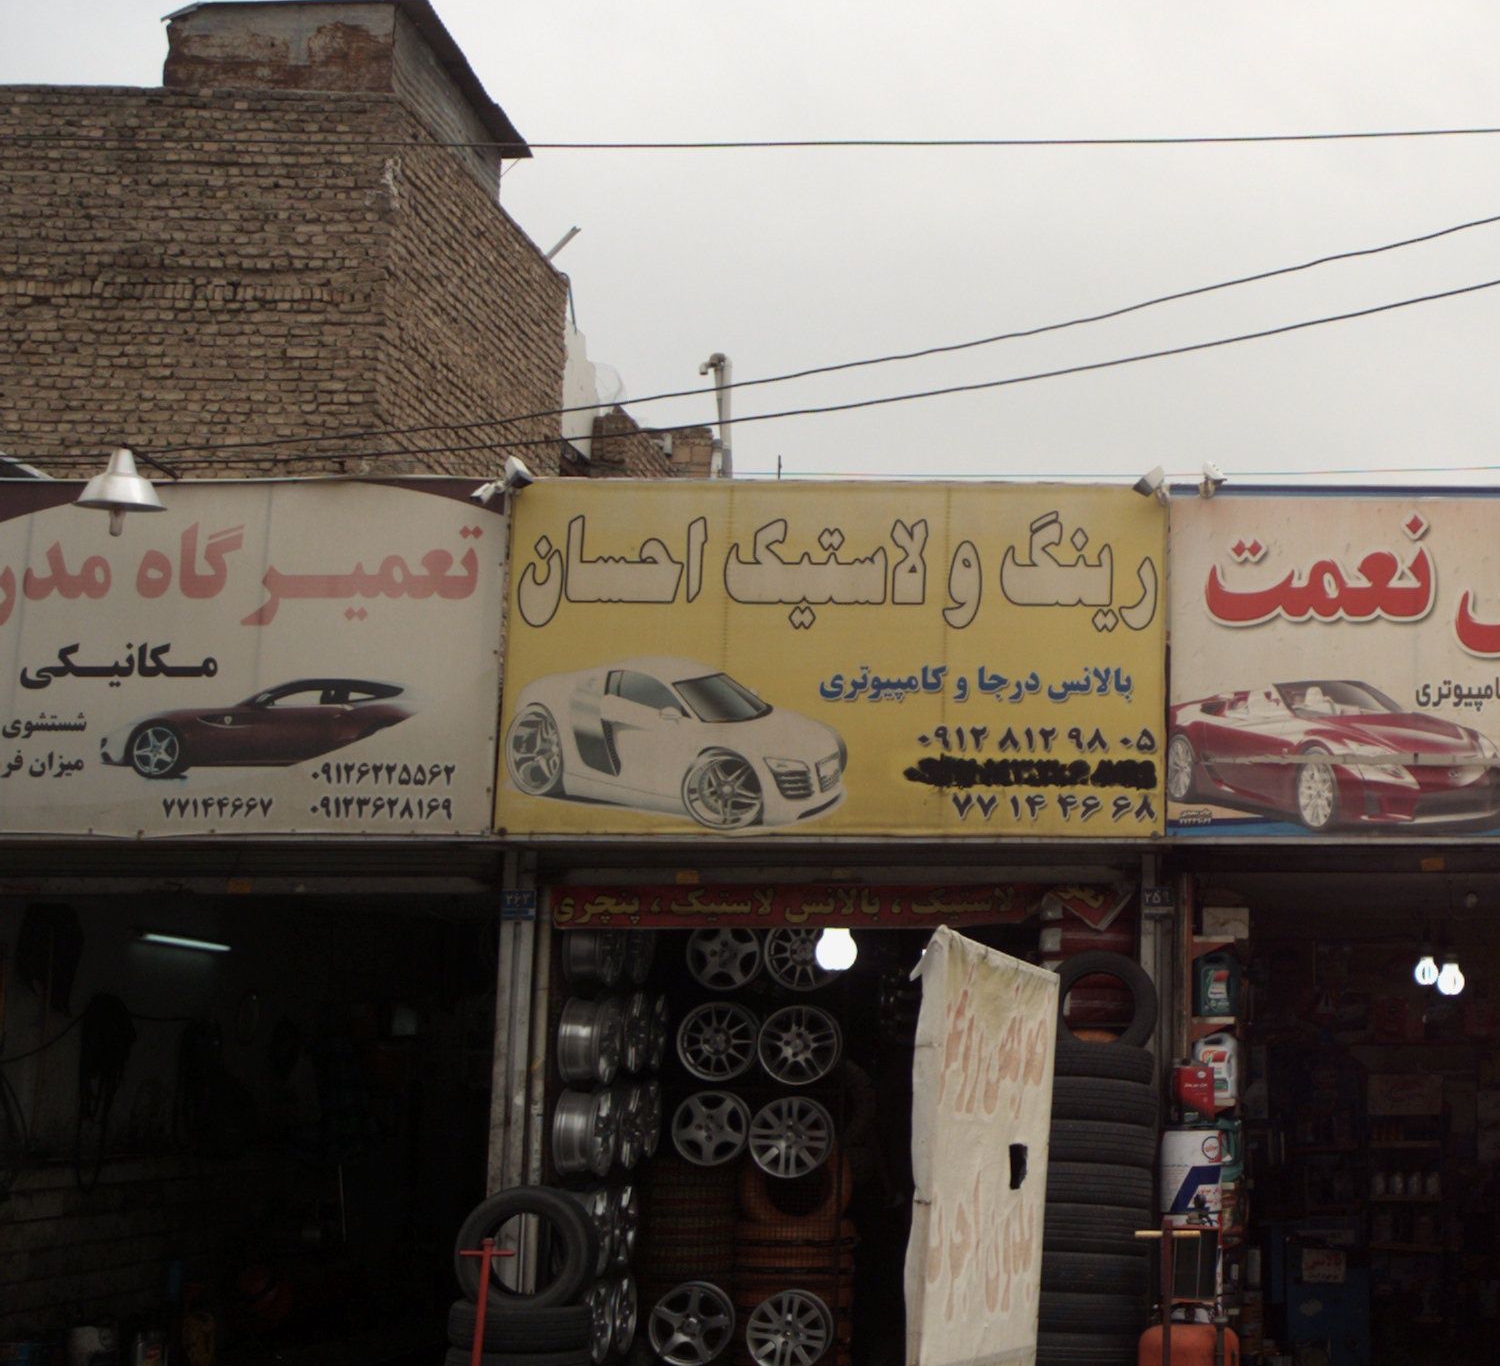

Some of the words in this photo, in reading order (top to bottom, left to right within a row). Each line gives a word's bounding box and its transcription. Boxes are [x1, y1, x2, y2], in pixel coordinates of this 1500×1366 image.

[517, 514, 709, 628] احسان
[724, 518, 929, 630] لاستیک
[943, 540, 983, 630] و
[1001, 510, 1159, 633] رینگ
[1205, 513, 1432, 624] نعمت
[20, 643, 218, 689] مکانیکی
[819, 665, 947, 702] کامپیوتری
[954, 676, 969, 701] و
[977, 666, 1041, 703] درجا
[1048, 667, 1132, 702] بالانس
[2, 712, 87, 739] شستشوی
[29, 751, 84, 777] میزان
[162, 797, 274, 819] ۷۷۱۴۴۶۶۷
[952, 793, 998, 819] ۷۷
[1010, 793, 1046, 820] ۱۴
[1057, 794, 1101, 820] ۴۶
[1112, 795, 1157, 822] ۶۸
[554, 891, 641, 924] پنچری
[785, 888, 881, 923] بالانس
